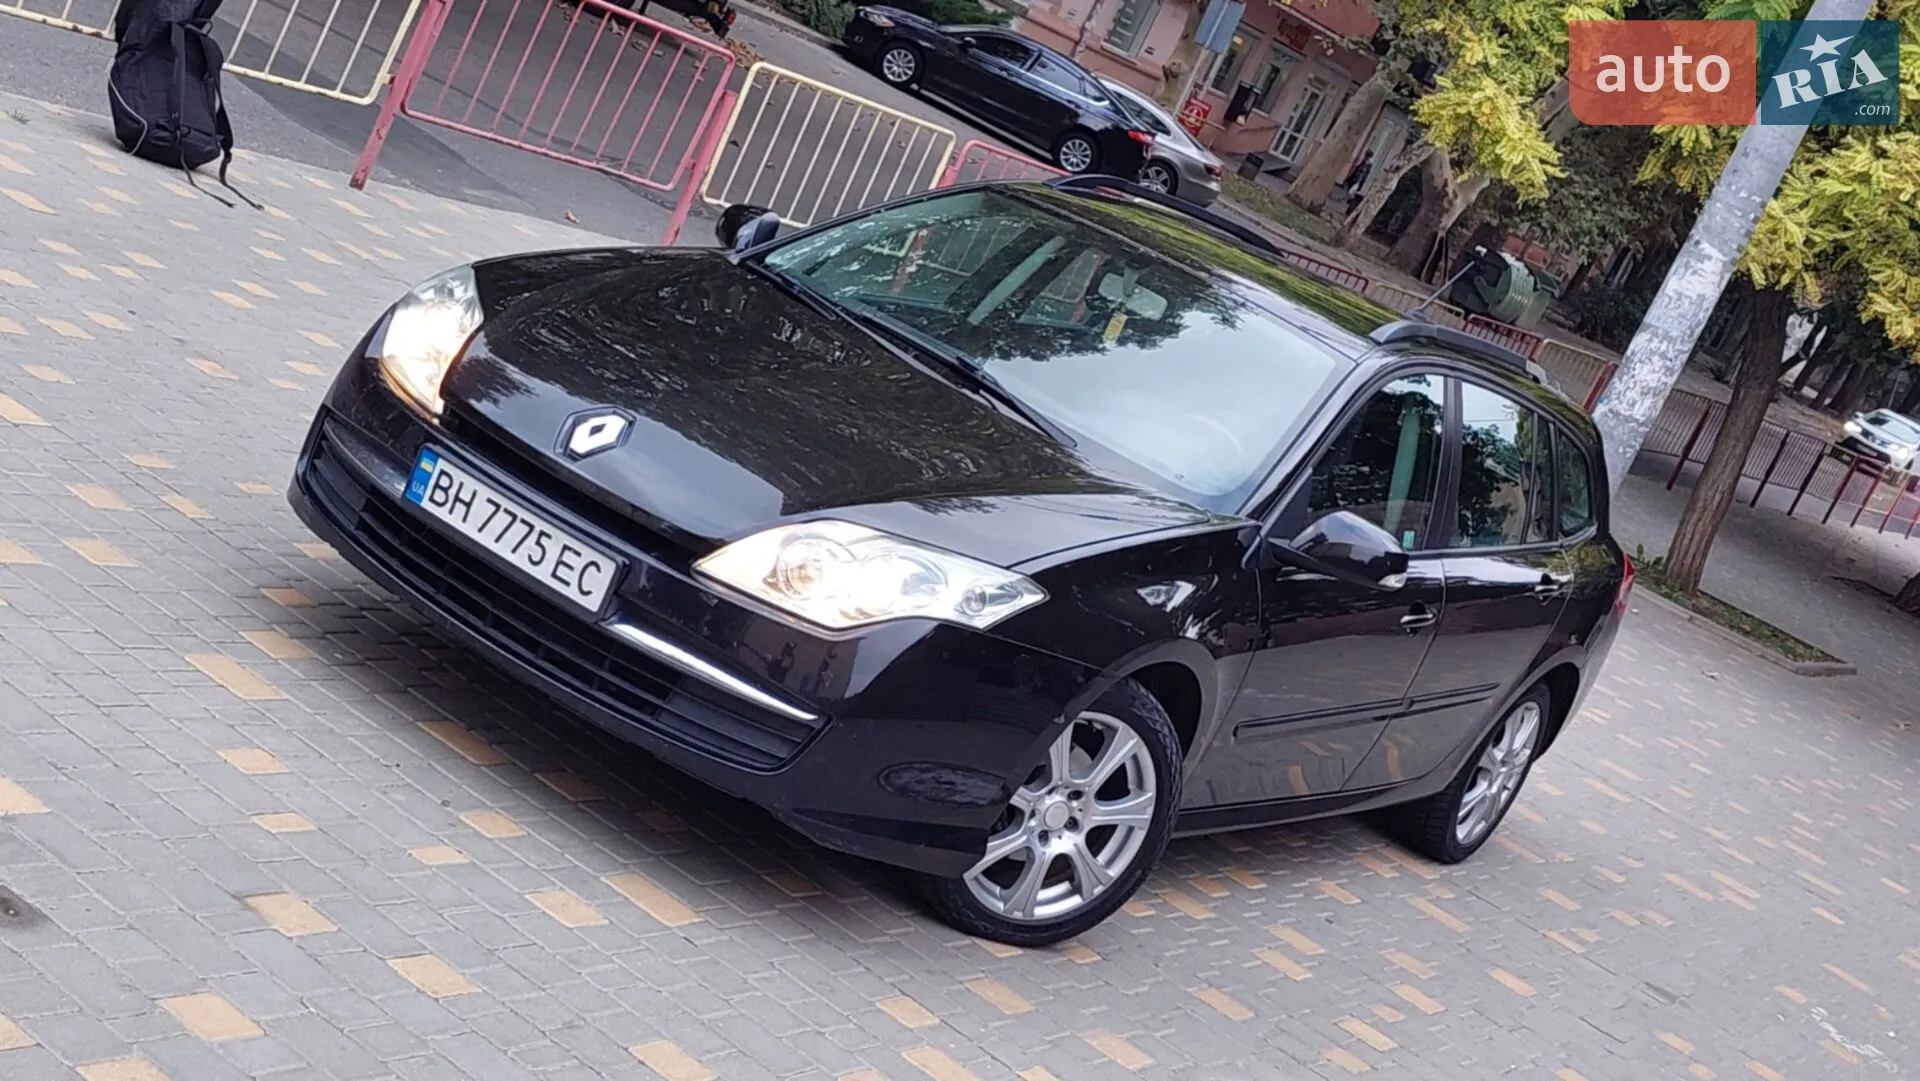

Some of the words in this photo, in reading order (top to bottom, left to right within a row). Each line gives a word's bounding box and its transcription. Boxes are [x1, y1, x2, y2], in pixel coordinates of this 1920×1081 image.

[411, 481, 425, 495] UA
[428, 469, 478, 523] BH
[477, 498, 552, 566] 7775
[550, 544, 602, 597] EC
